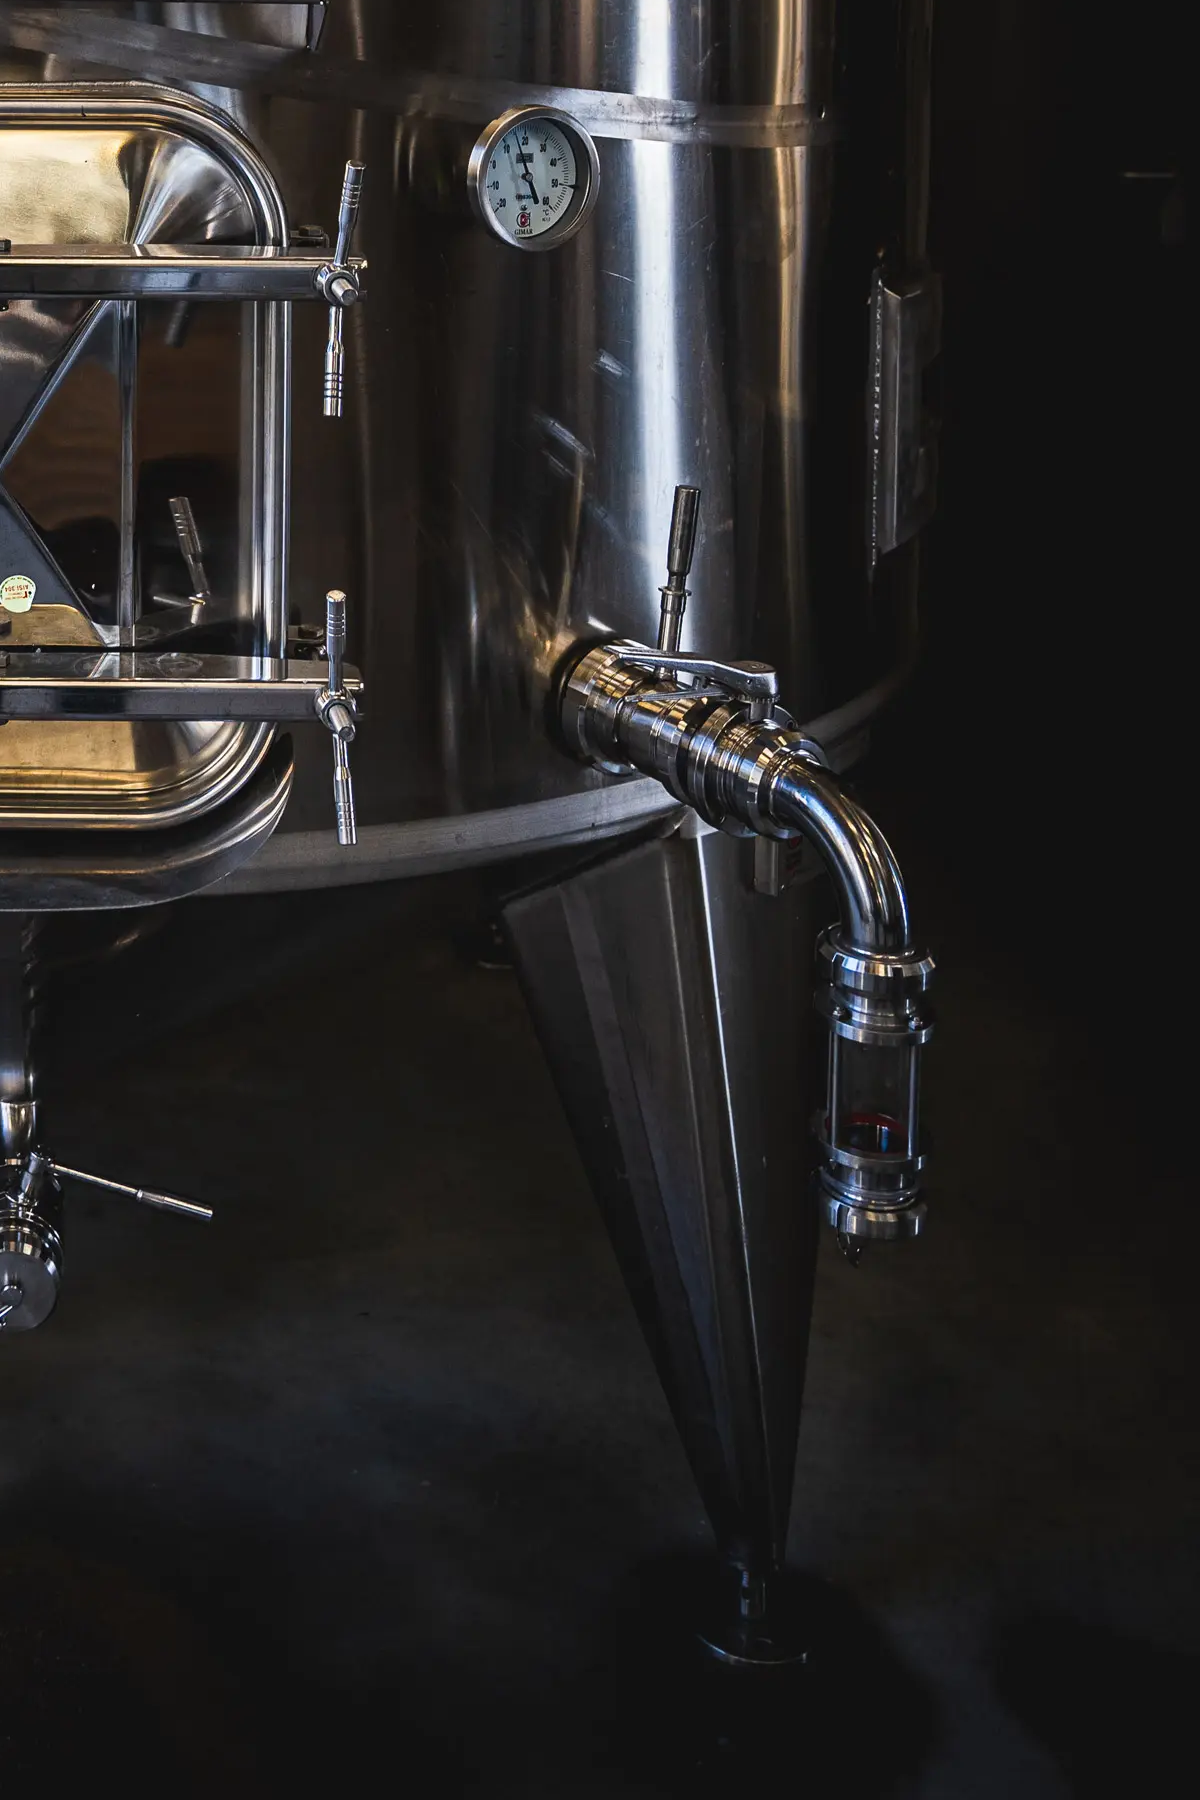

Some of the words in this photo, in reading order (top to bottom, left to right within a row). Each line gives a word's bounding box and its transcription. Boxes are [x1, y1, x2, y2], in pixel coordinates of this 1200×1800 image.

[521, 136, 529, 146] 20
[503, 144, 511, 154] 10
[539, 143, 547, 153] 30
[550, 157, 557, 167] 40
[551, 178, 559, 188] 50
[542, 196, 550, 206] 60
